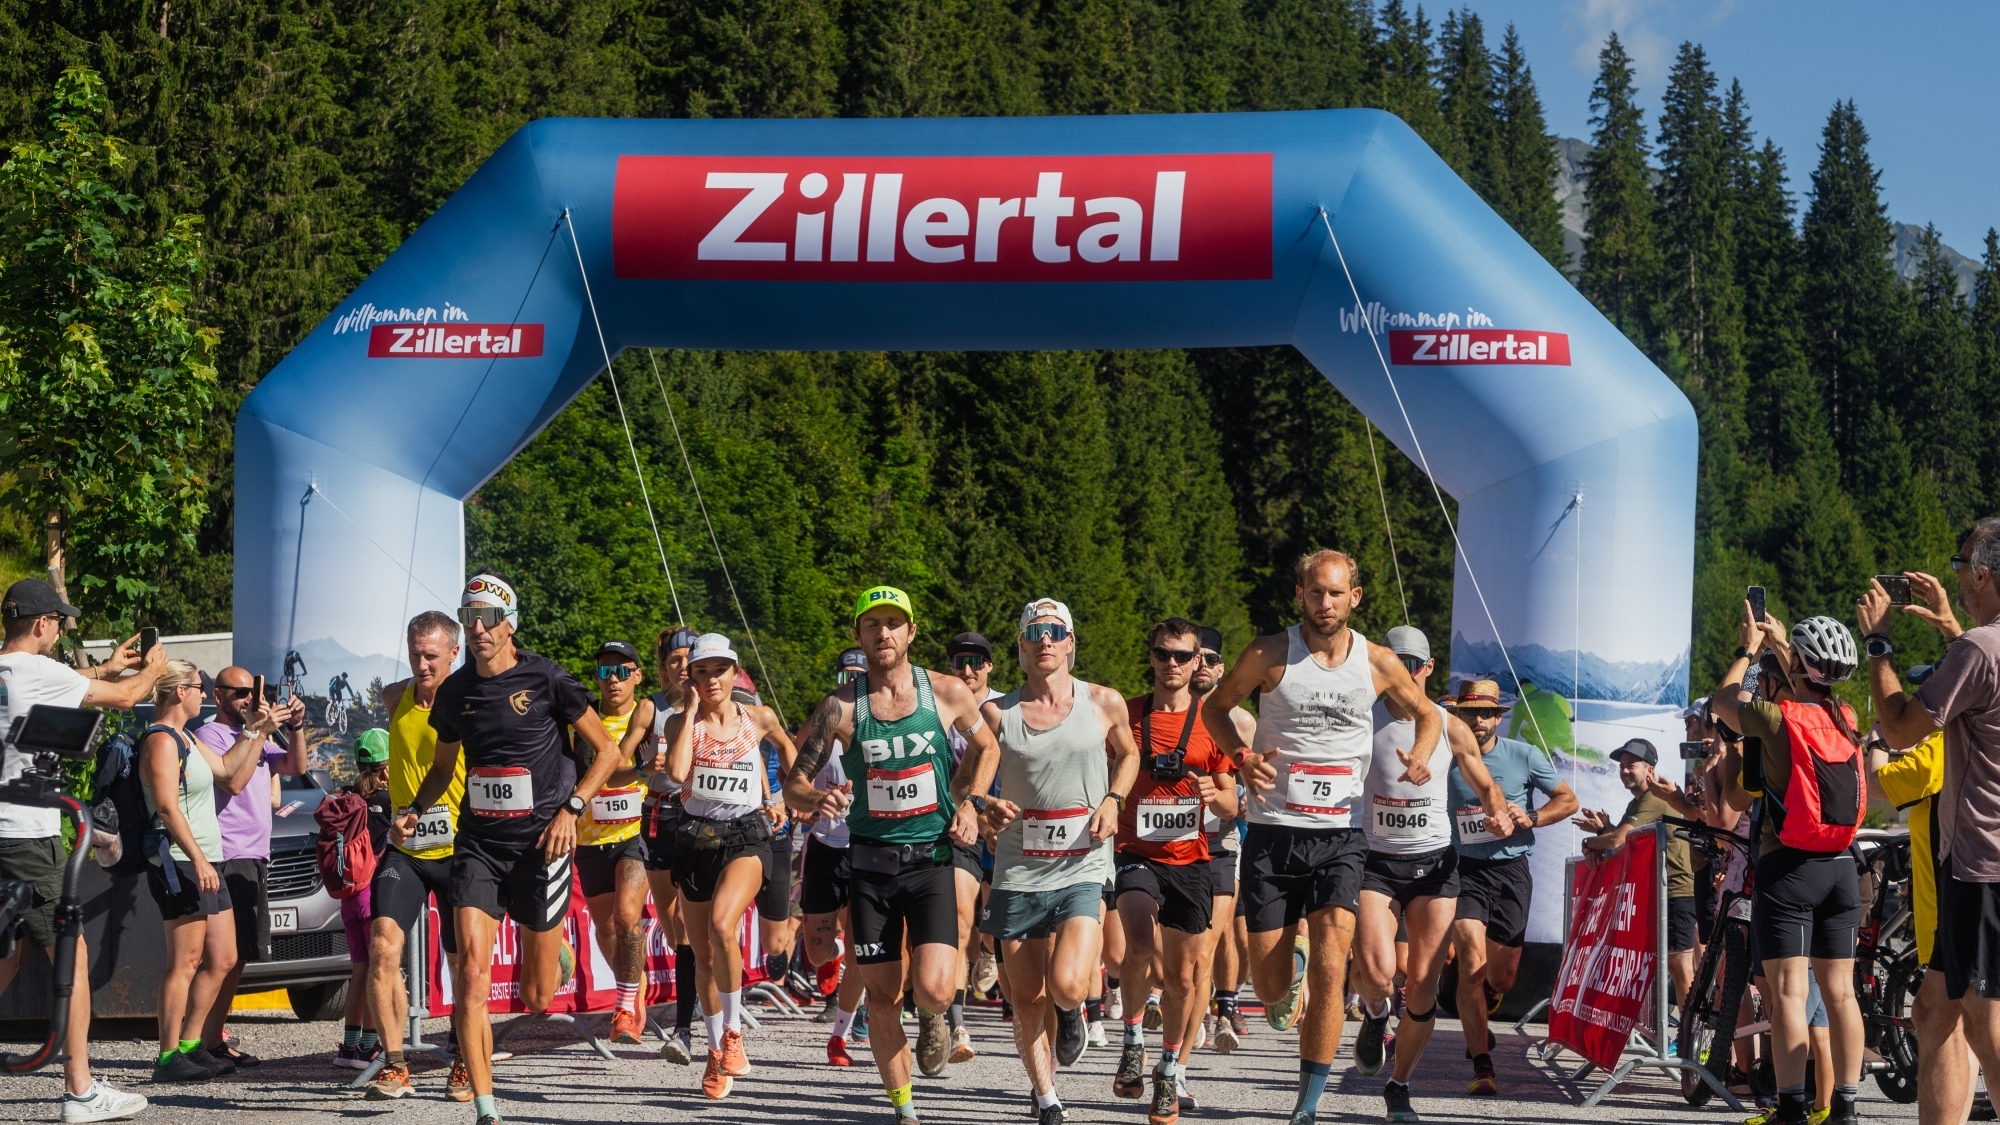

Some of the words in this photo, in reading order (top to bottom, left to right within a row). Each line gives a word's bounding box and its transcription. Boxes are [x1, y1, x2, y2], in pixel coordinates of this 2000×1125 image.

[698, 171, 1186, 263] Zillertal
[333, 303, 437, 335] Willkommen
[443, 302, 469, 322] im
[1340, 302, 1460, 335] Willkommen
[1467, 307, 1494, 328] im
[389, 328, 522, 354] Zillertal
[1412, 334, 1547, 361] Zillertal
[870, 590, 899, 602] BIX
[1316, 691, 1342, 700] NIKE
[1300, 705, 1355, 715] RUNNING
[861, 731, 936, 763] BIX
[695, 759, 709, 767] race
[712, 761, 730, 769] result
[732, 763, 753, 771] austria
[483, 783, 513, 800] 108
[697, 774, 749, 793] 10774
[1312, 780, 1332, 797] 75
[886, 783, 918, 801] 149
[426, 804, 449, 813] austria
[605, 799, 629, 811] 150
[1139, 797, 1153, 805] race
[1155, 797, 1175, 805] result
[1178, 797, 1200, 805] austria
[1388, 799, 1407, 807] result
[1409, 798, 1432, 807] austria
[1467, 807, 1484, 815] result
[1142, 812, 1197, 829] 10803
[1377, 811, 1428, 828] 10946
[1461, 819, 1486, 834] 109
[1046, 825, 1067, 840] 74
[274, 913, 291, 928] DZ
[854, 942, 886, 956] BIX
[492, 982, 510, 1000] ERSTE
